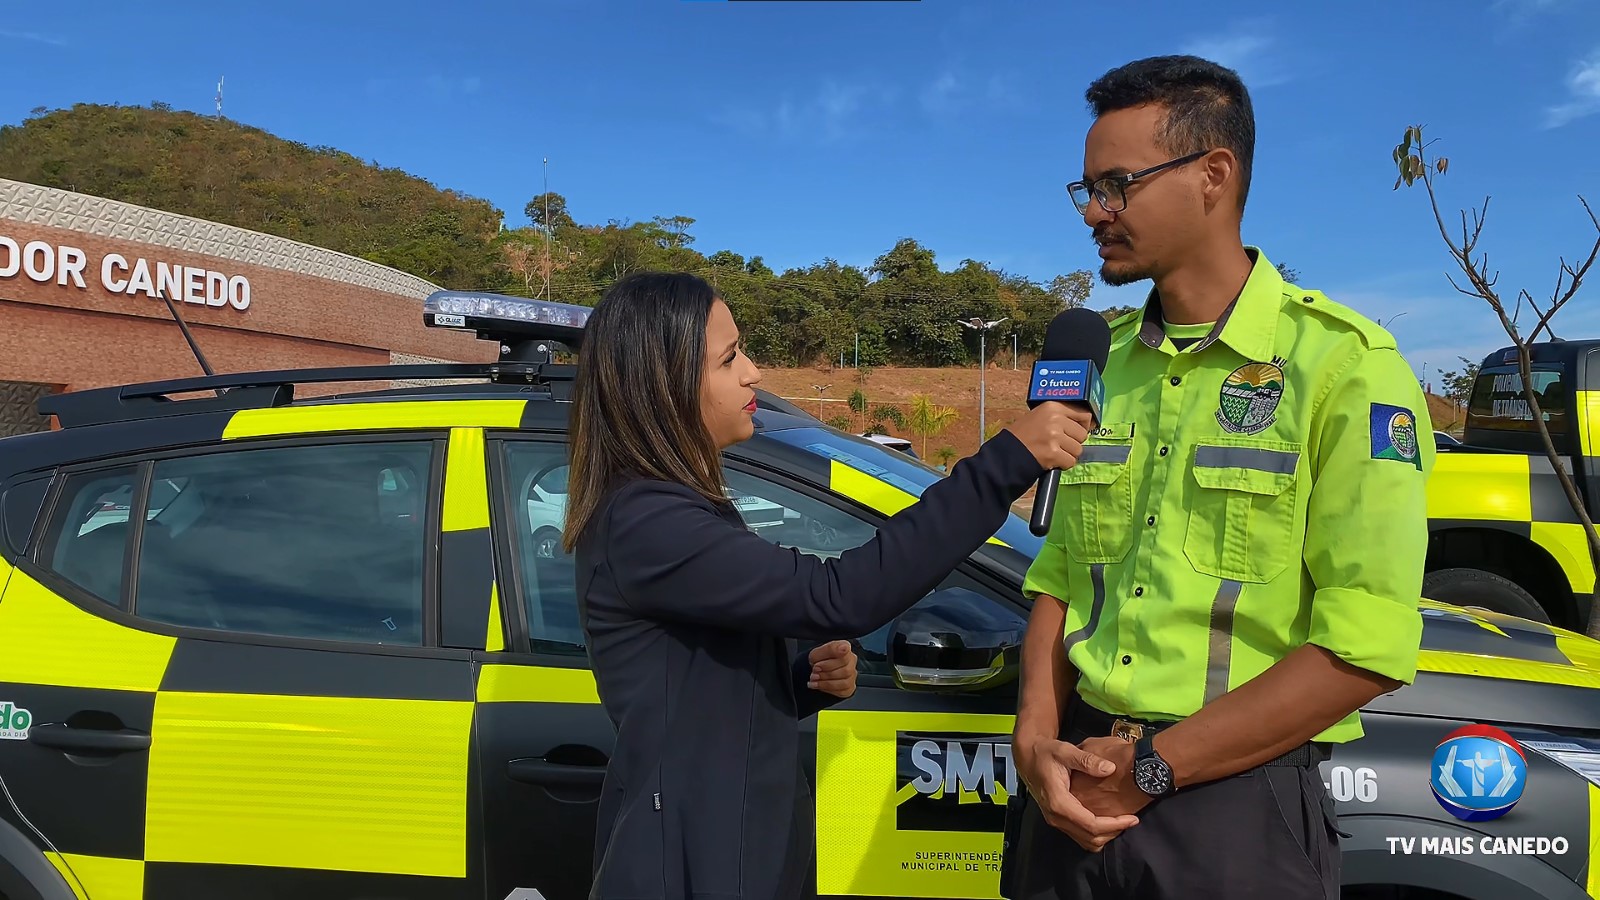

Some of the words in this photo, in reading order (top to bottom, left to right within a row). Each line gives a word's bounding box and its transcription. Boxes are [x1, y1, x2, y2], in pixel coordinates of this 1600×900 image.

[101, 253, 251, 311] CANEDO
[1039, 379, 1048, 387] O
[1049, 378, 1080, 387] futuro
[1045, 388, 1080, 396] AGORA
[911, 740, 1018, 796] SMT
[901, 862, 959, 871] MUNICIPAL
[965, 863, 979, 871] DE
